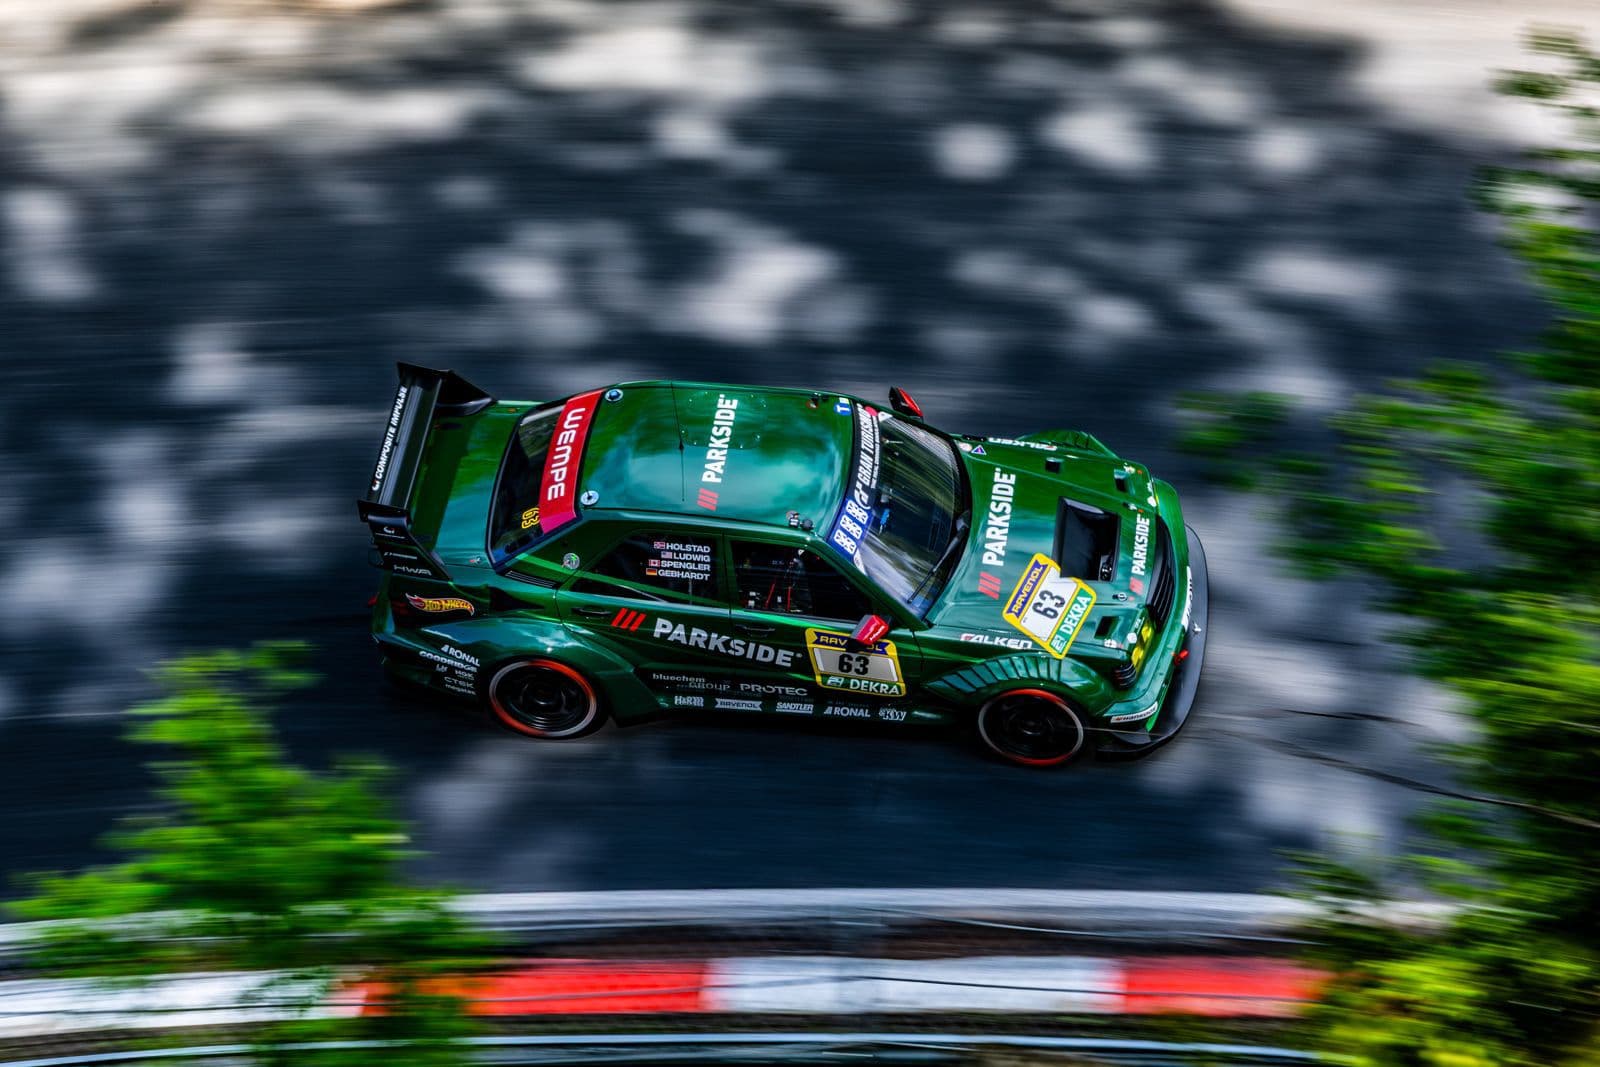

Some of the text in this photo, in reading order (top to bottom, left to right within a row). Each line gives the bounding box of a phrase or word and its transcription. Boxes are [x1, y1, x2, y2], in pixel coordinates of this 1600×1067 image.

[374, 385, 408, 479] COMPOSITE IMPULSE
[702, 397, 739, 483] PARKSIDE
[857, 407, 875, 455] TURISMO
[547, 407, 586, 500] WEMPE
[857, 454, 874, 487] GRAN
[521, 507, 540, 529] 63
[982, 471, 1017, 566] PARKSIDE
[666, 542, 711, 553] HOLSTAD
[1131, 514, 1150, 576] PARKSIDE
[660, 560, 711, 571] SPENGLER
[673, 552, 711, 562] LUDWIG
[658, 569, 710, 580] GEBHARDT
[1011, 566, 1044, 613] RAVENOL
[1032, 590, 1066, 619] 63
[1062, 596, 1093, 635] DEKRA
[653, 617, 793, 668] PARKSIDE
[448, 647, 480, 667] RONAL
[838, 653, 870, 676] 63
[652, 672, 705, 682] bluechem
[849, 678, 900, 695] DEKRA
[739, 683, 808, 697] PROTEC
[776, 702, 814, 712] SANDTLER
[833, 706, 871, 718] RONAL
